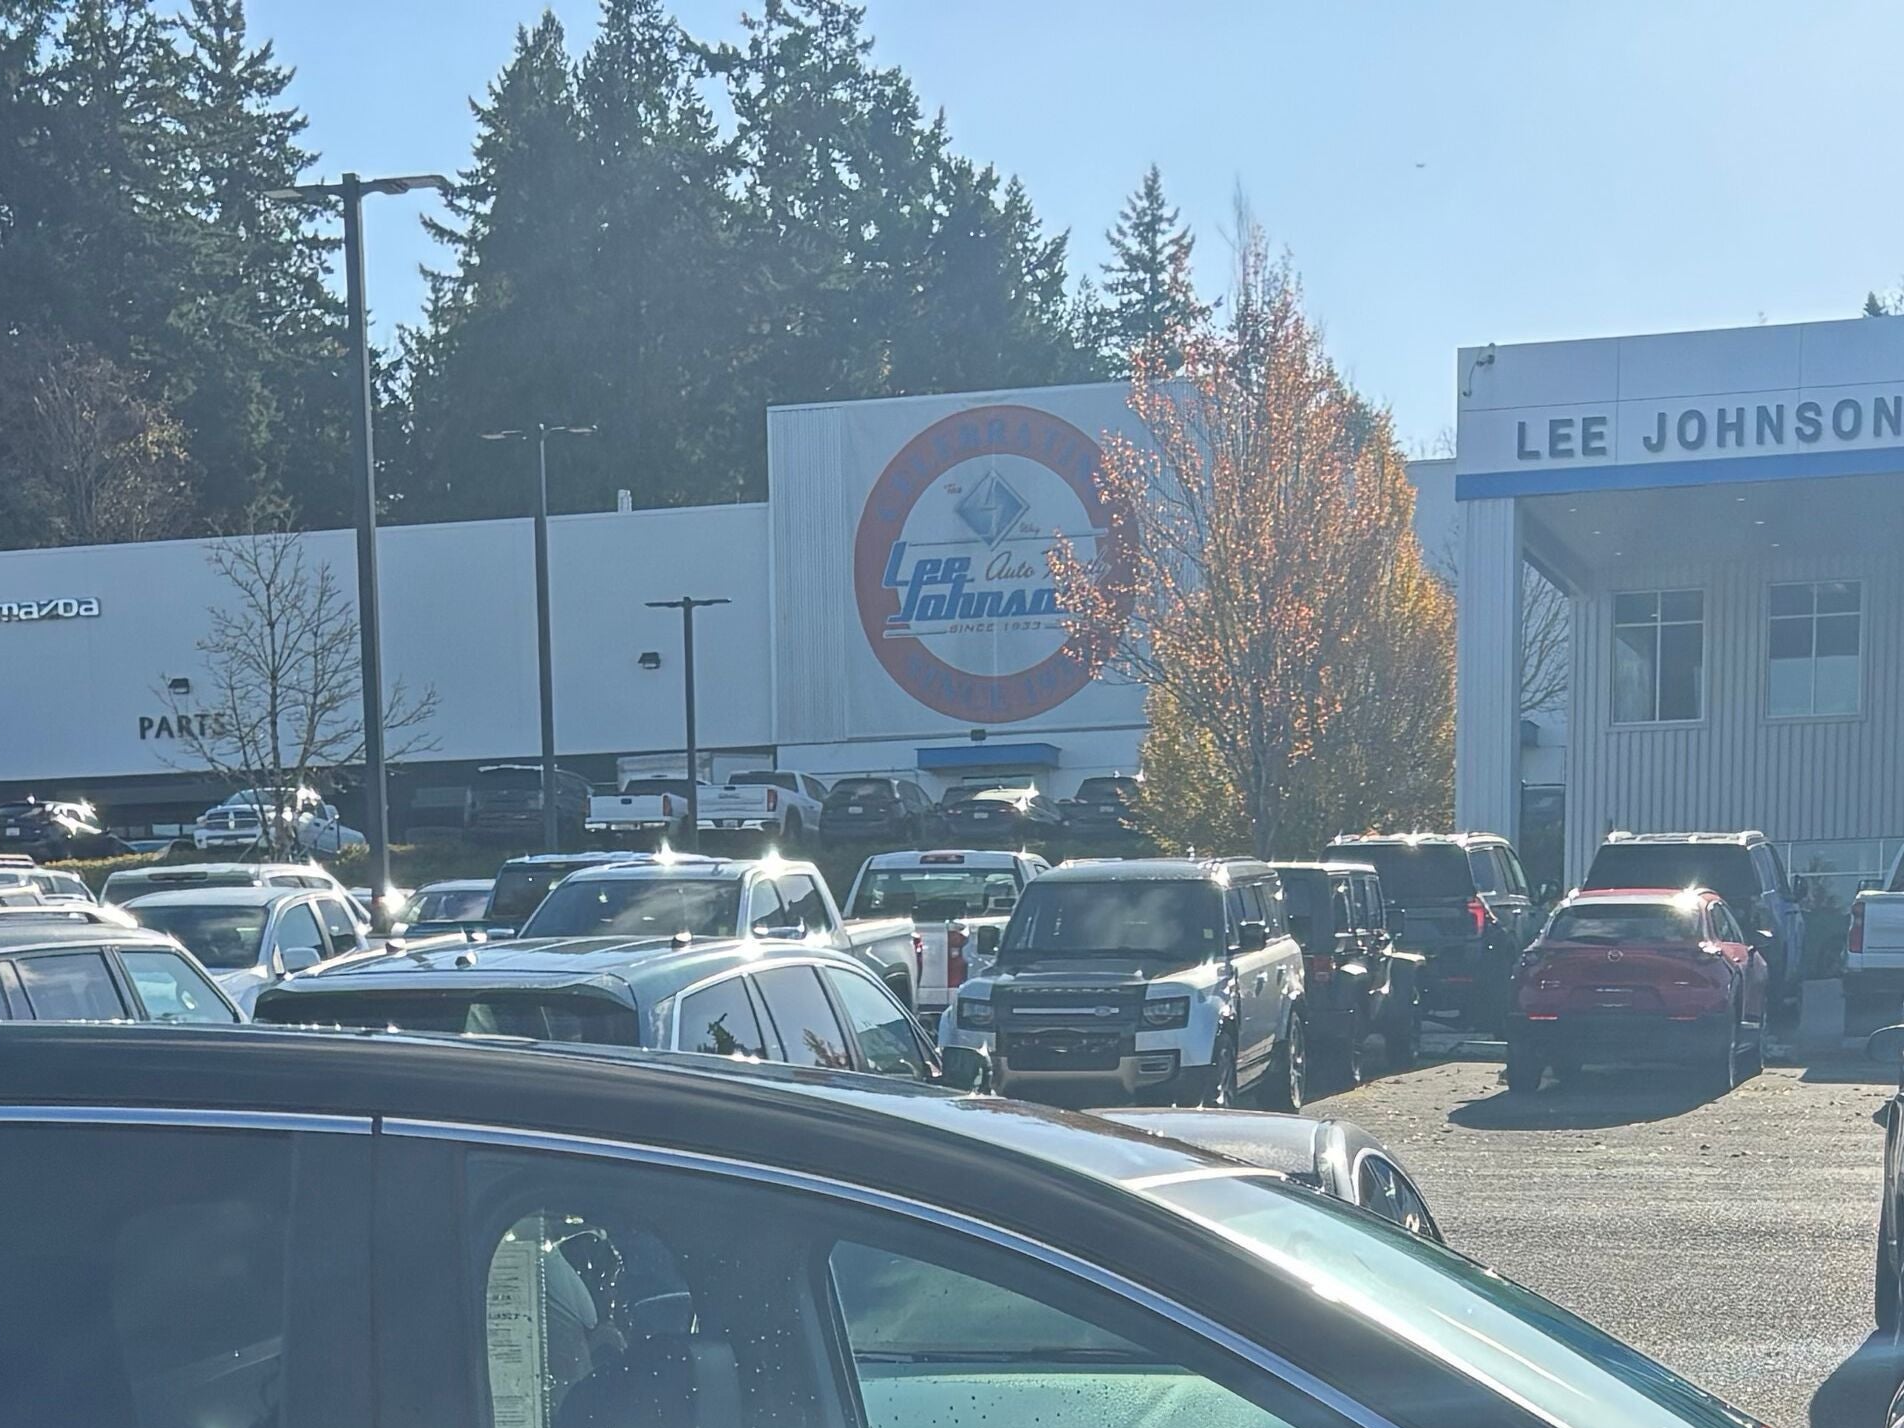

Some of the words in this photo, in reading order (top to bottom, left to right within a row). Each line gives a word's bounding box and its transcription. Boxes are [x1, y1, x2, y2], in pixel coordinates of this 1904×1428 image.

[1516, 416, 1608, 461] LEE
[1642, 395, 1904, 454] JOHNSON
[882, 541, 974, 588] Lee
[986, 551, 1035, 582] Auto
[949, 622, 994, 634] SINCE
